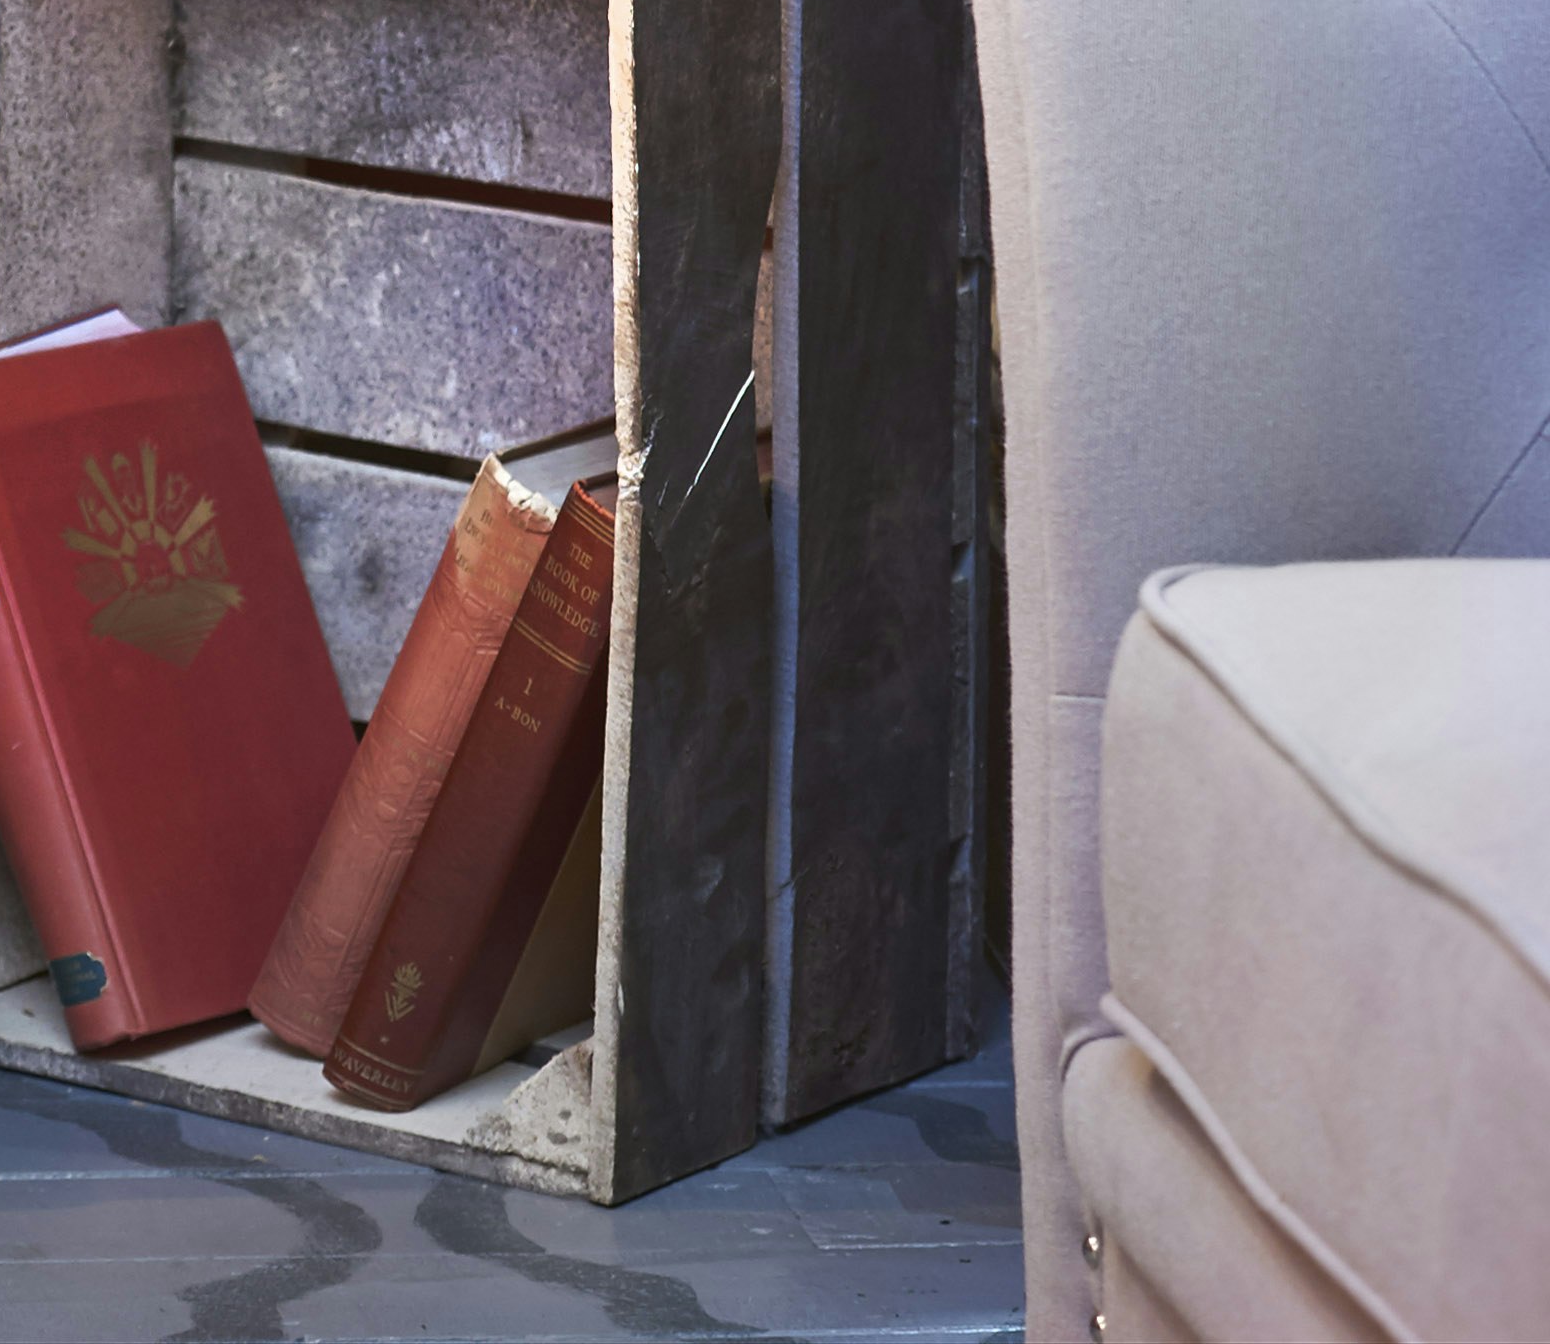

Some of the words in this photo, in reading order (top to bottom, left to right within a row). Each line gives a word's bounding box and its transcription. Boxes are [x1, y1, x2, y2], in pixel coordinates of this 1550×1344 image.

[570, 542, 594, 572] THE
[544, 554, 580, 595] BOOK
[580, 584, 601, 607] OF
[494, 695, 543, 734] A-BON
[333, 1046, 415, 1094] WAVERLEY
